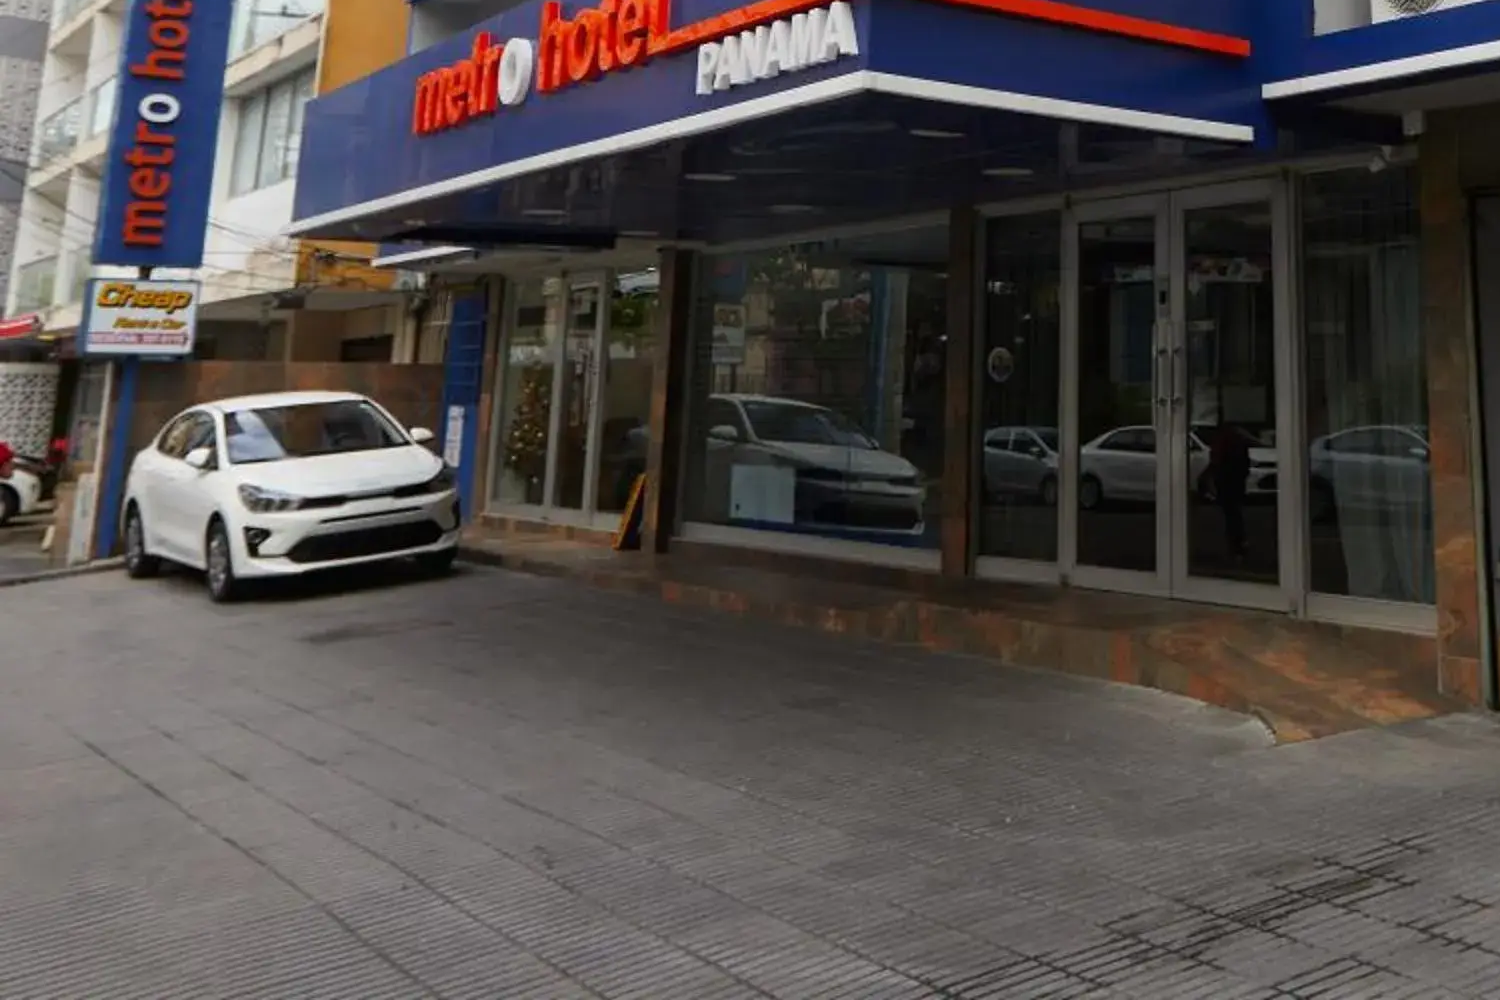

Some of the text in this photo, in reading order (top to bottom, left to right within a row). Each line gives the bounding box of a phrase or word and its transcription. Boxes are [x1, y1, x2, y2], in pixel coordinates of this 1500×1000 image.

[412, 31, 533, 137] metro
[695, 0, 859, 96] PANAMA
[123, 92, 180, 248] metro
[97, 282, 193, 314] Cheap
